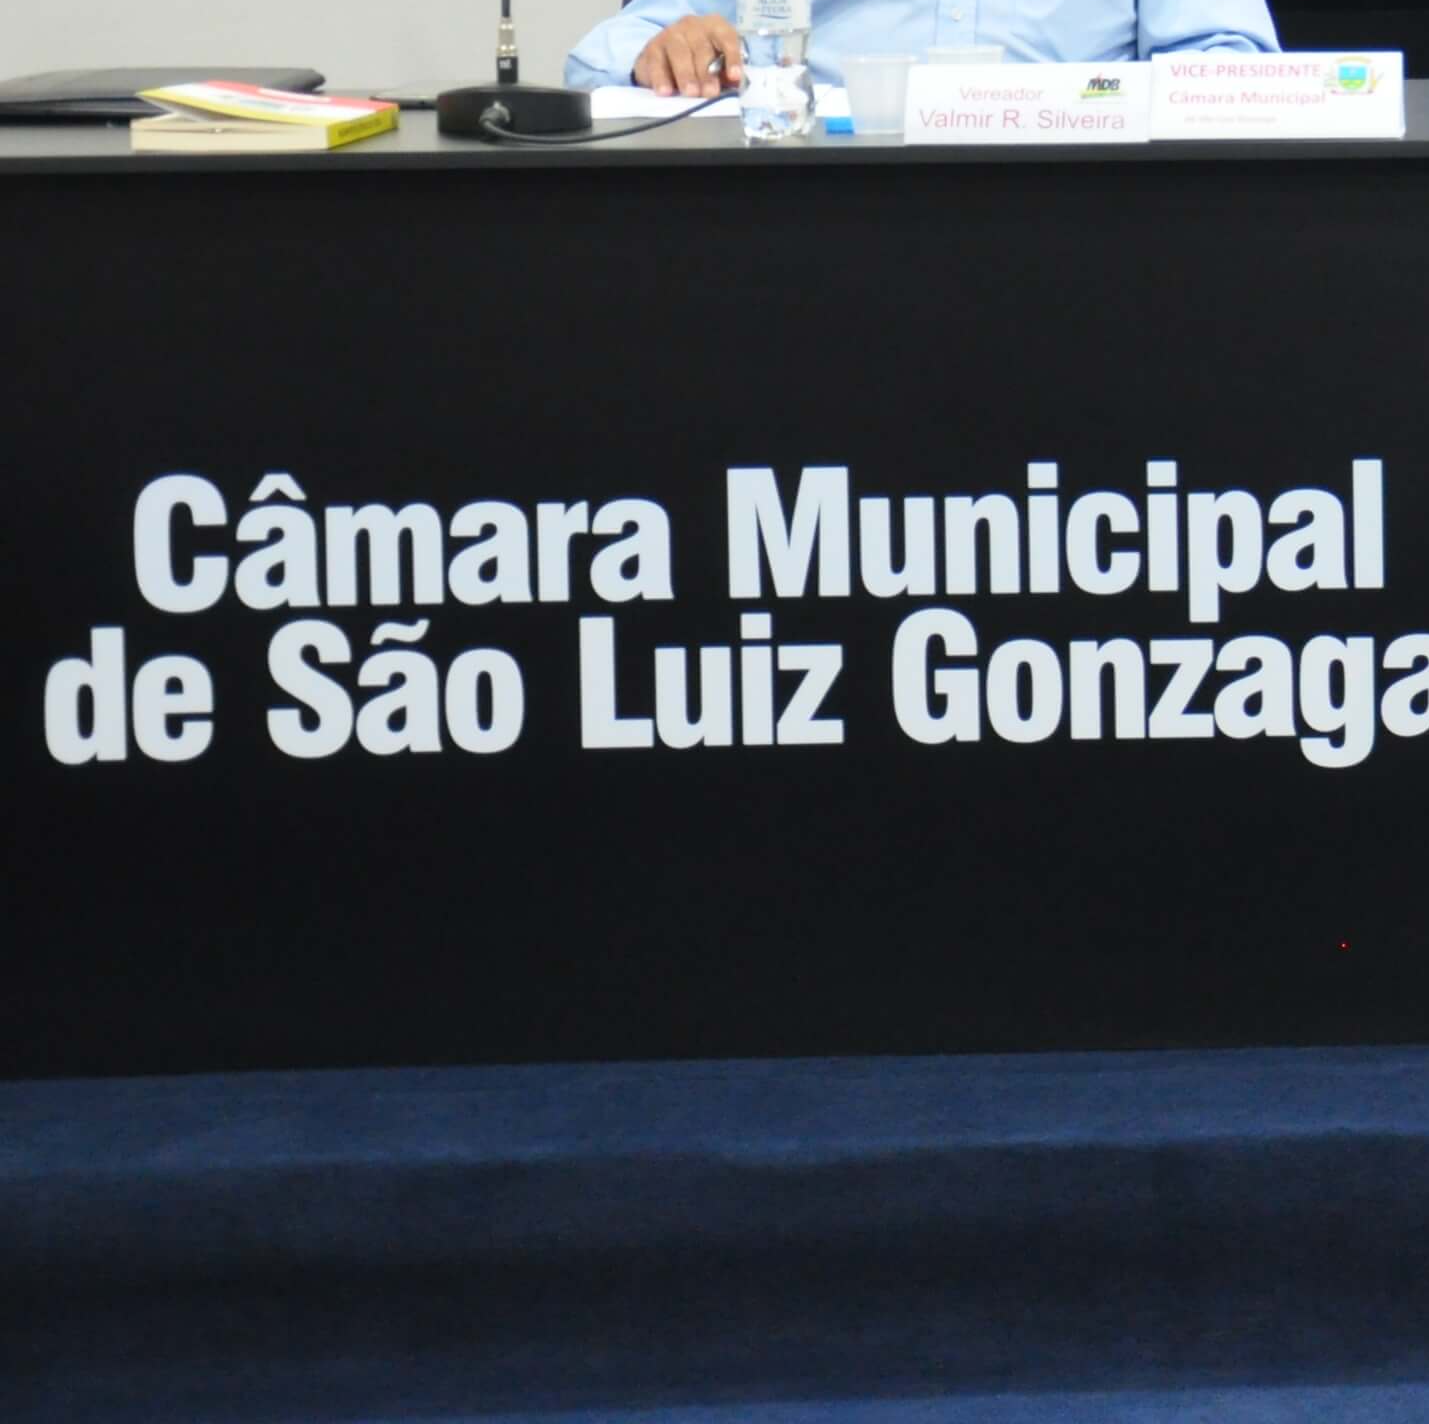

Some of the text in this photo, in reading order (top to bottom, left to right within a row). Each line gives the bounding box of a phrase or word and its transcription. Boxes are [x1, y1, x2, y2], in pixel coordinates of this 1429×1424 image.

[1169, 63, 1321, 78] VICE-PRESIDENTE
[1085, 76, 1121, 92] MDB
[959, 86, 1044, 102] Vereador
[1168, 90, 1326, 107] Câmara Municipal
[919, 108, 1126, 130] Valmir R. Silveira
[133, 458, 1385, 623] Câmara Municipal
[44, 626, 215, 765] de
[267, 618, 525, 759] São
[579, 612, 845, 749] Luiz
